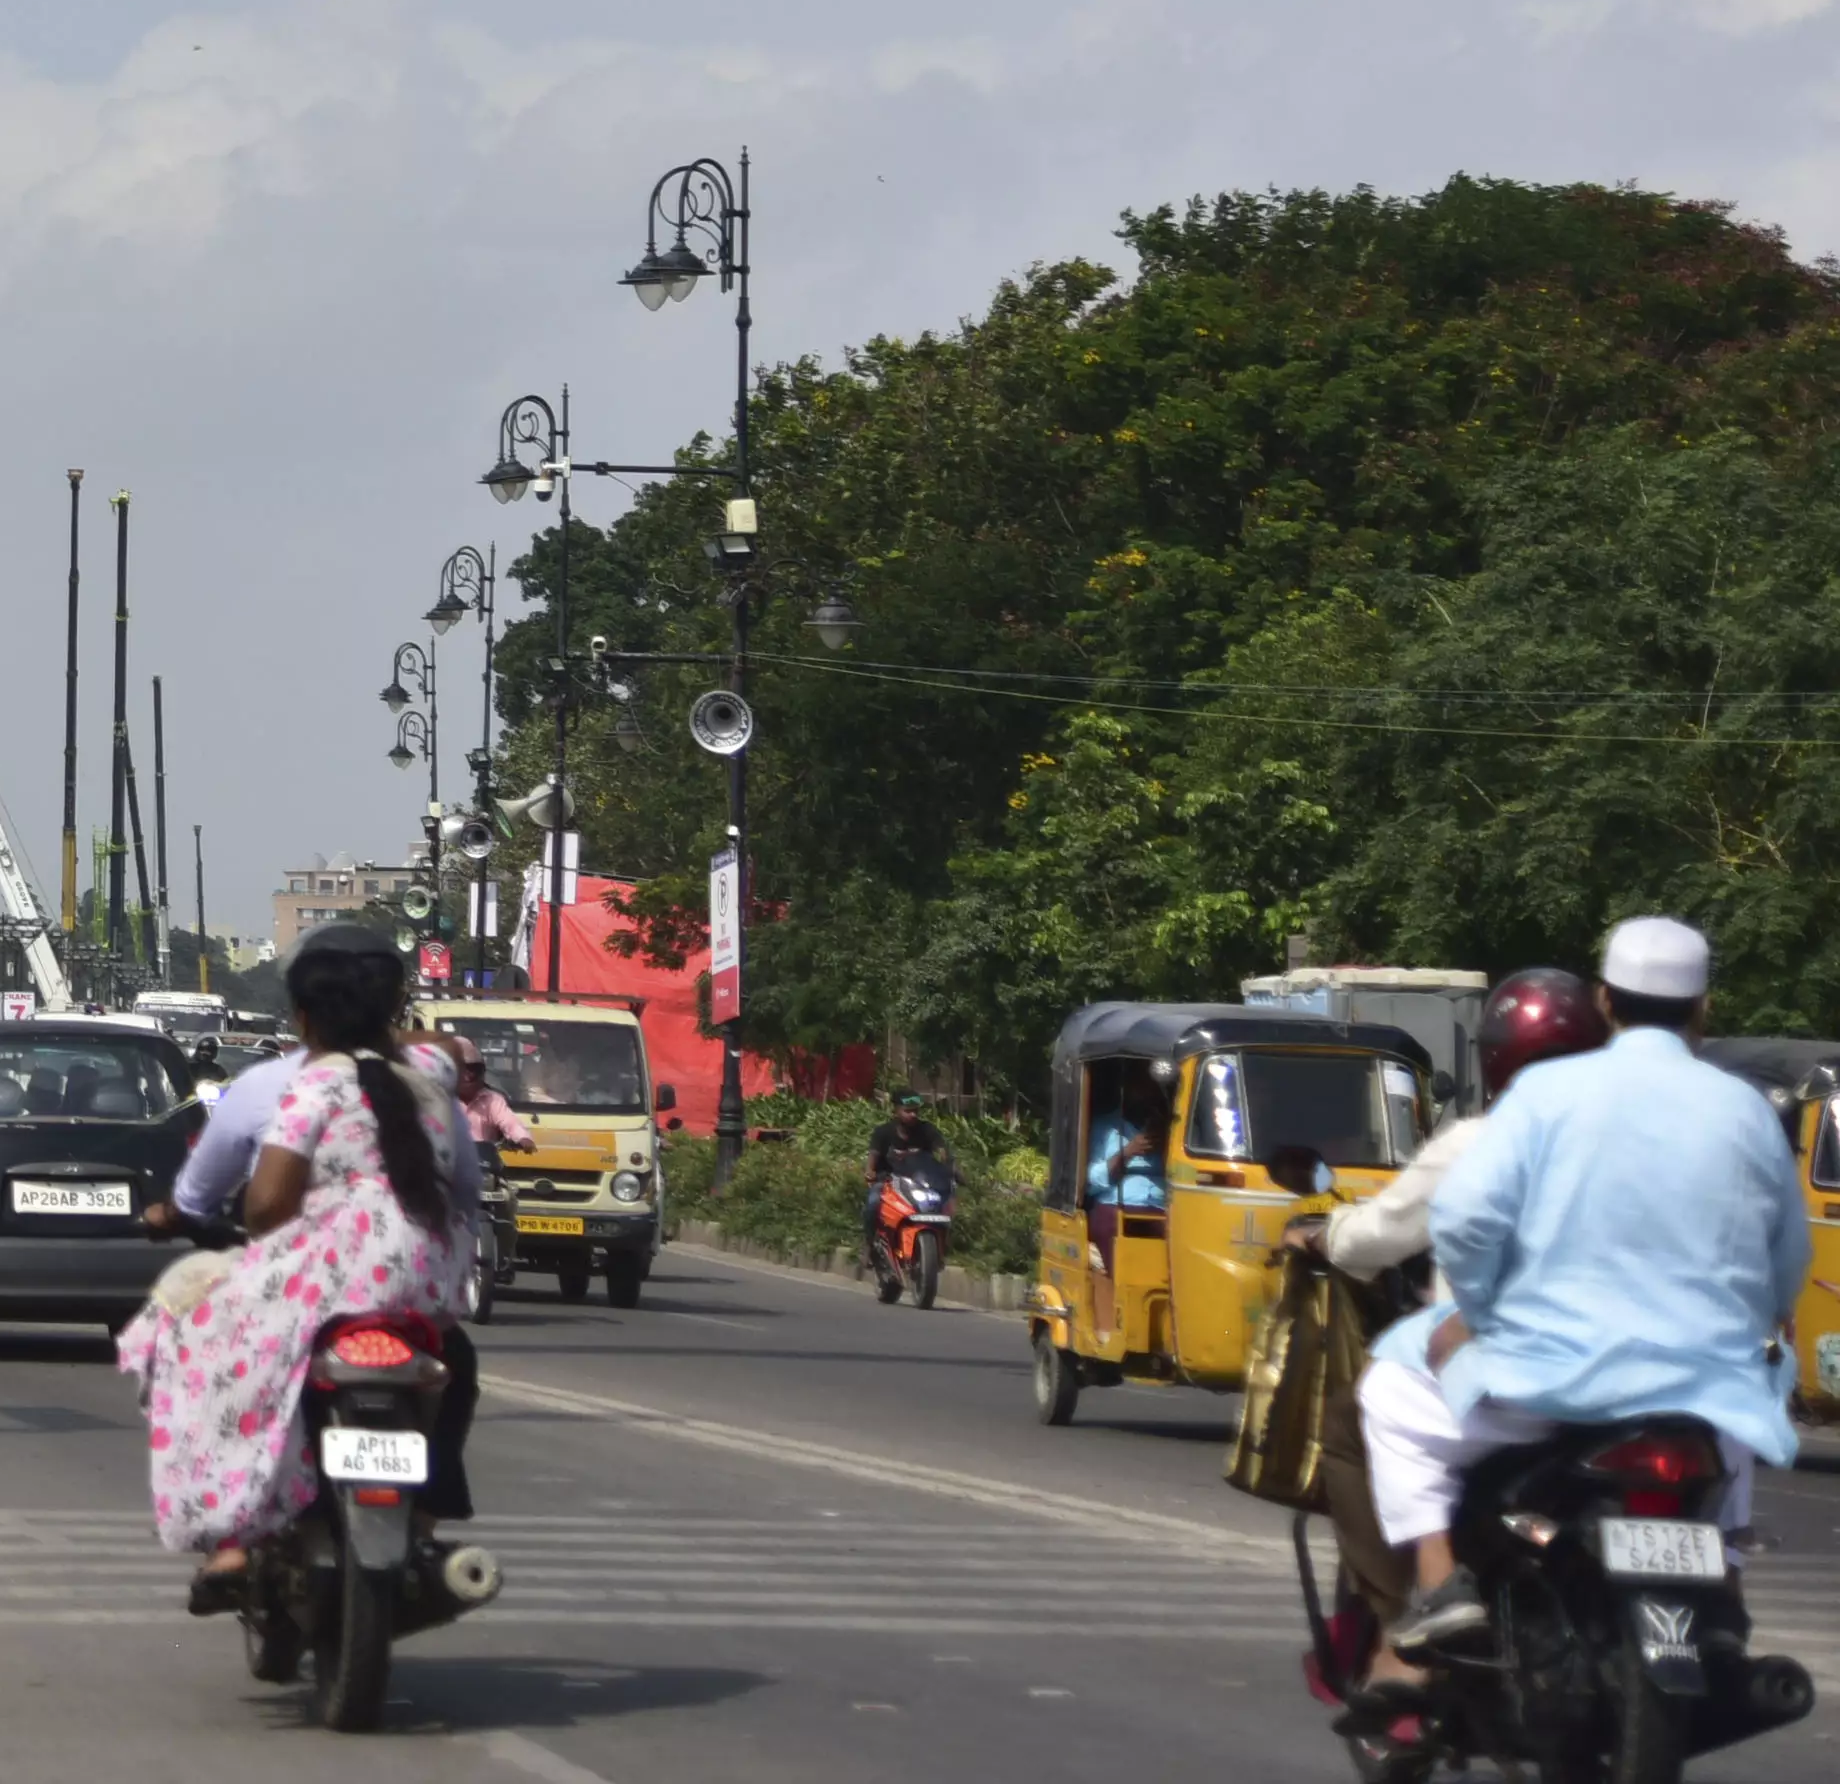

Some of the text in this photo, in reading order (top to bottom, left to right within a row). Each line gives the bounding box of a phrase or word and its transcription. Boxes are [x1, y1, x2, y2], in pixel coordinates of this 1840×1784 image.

[9, 1004, 26, 1021] 7
[85, 1192, 126, 1207] 3926
[372, 1456, 412, 1474] 1683
